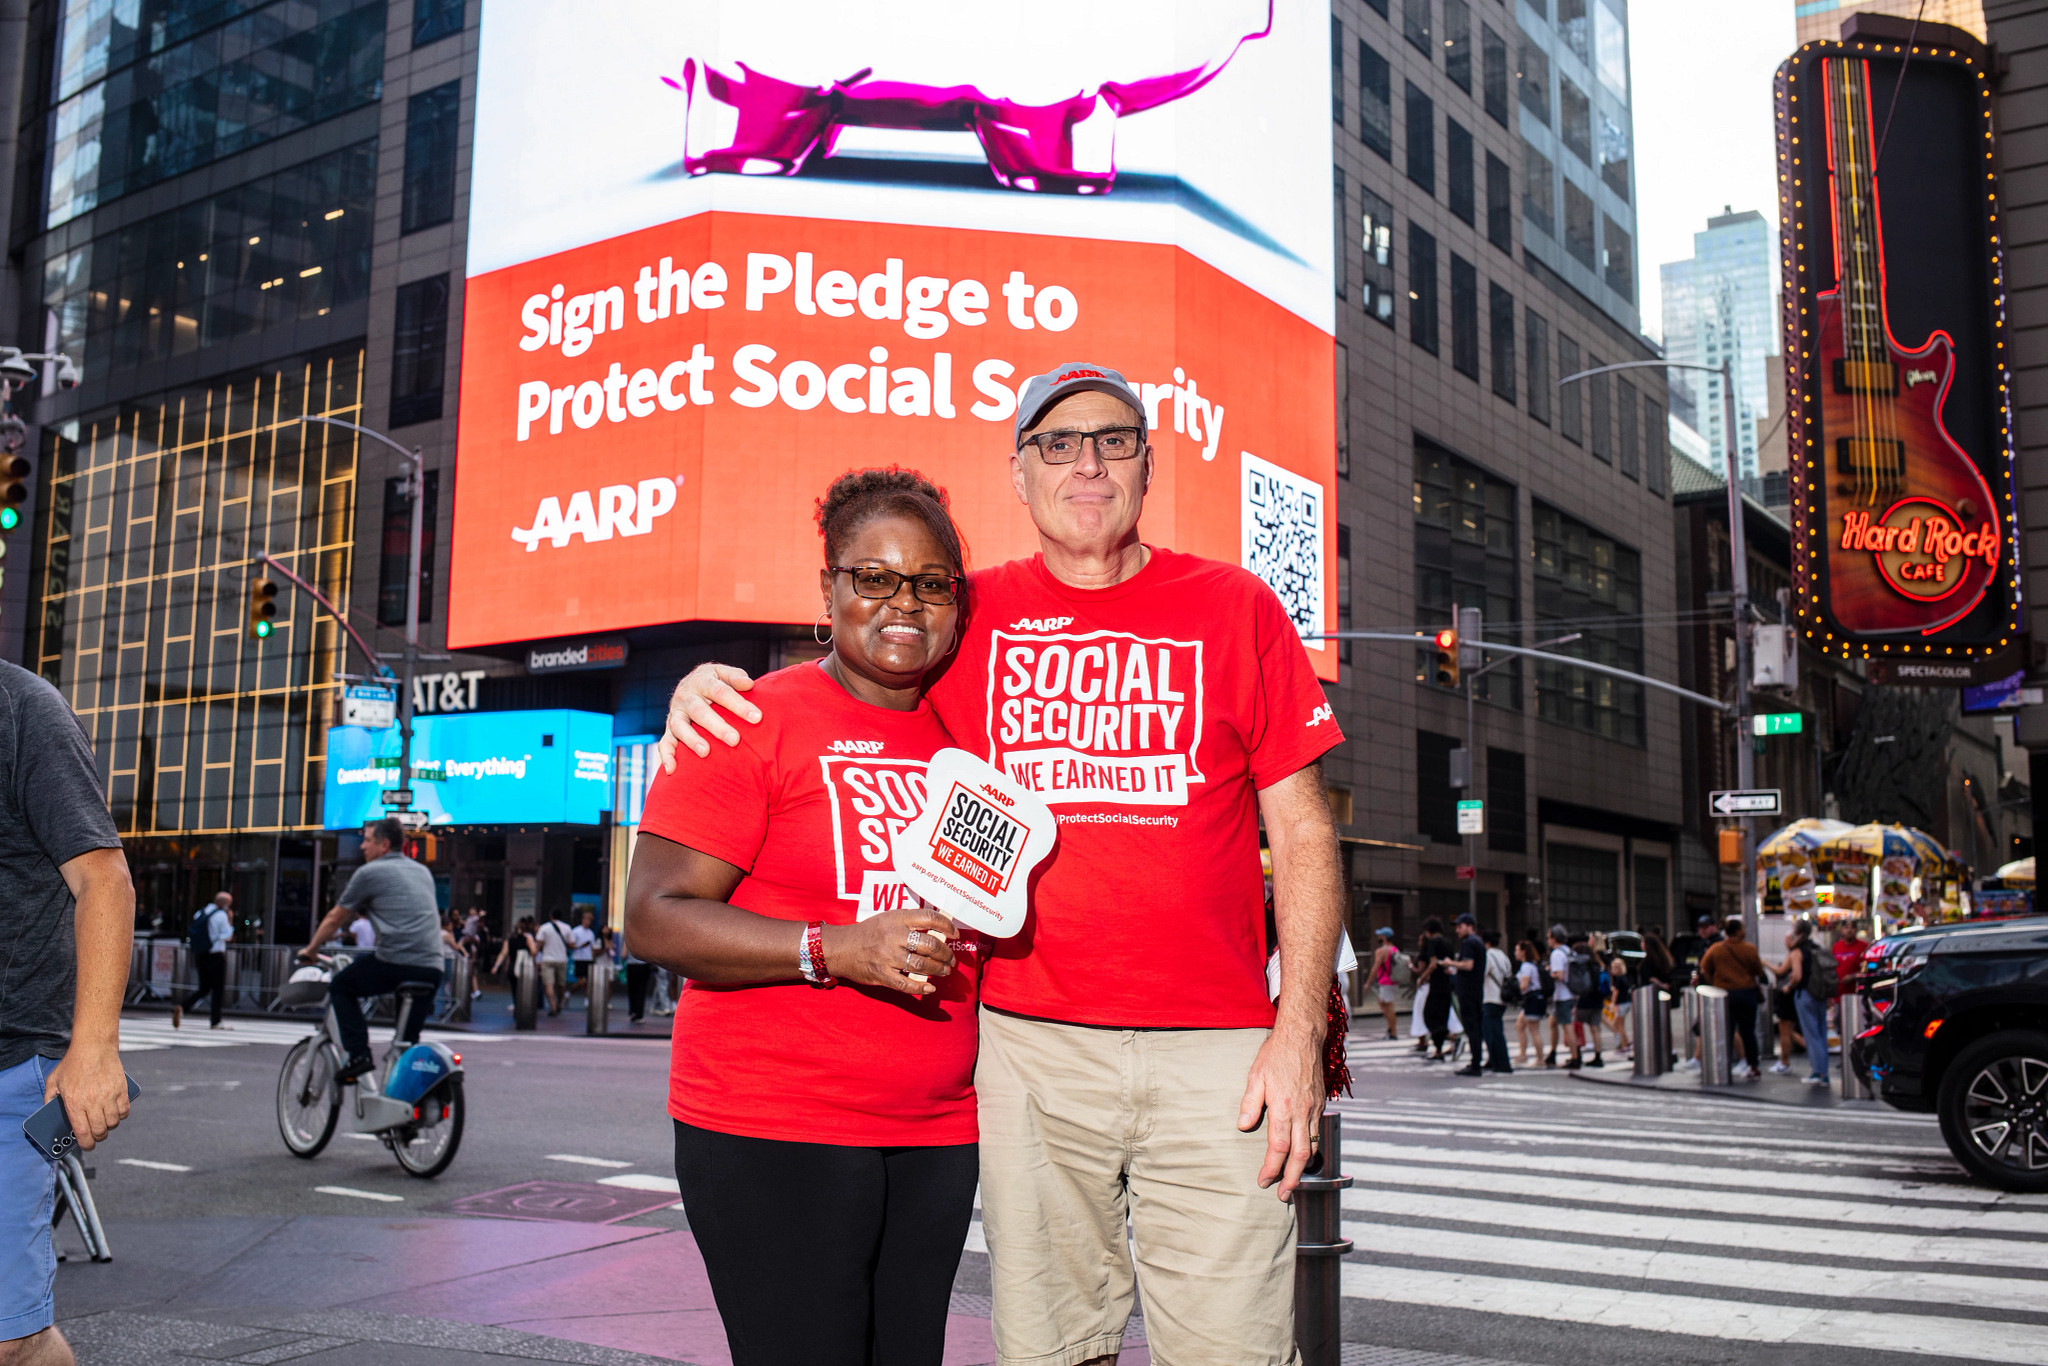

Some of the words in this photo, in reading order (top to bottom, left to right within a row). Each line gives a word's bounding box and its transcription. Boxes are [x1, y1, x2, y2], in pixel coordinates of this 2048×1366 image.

[518, 283, 625, 358] Sign
[633, 256, 729, 324] the
[738, 251, 990, 340] Pledge
[1001, 270, 1079, 332] to
[516, 343, 715, 442] Protect
[729, 346, 957, 420] Social
[969, 358, 1225, 462] Srity
[510, 474, 684, 553] AARP
[1841, 510, 1921, 552] Hard
[1923, 515, 1998, 567] Rock
[1900, 561, 1946, 582] CAFE
[1009, 616, 1074, 632] AARP
[1002, 641, 1185, 703] SOCIAL
[1897, 665, 1972, 679] SPECTACOLOR
[999, 697, 1185, 751] SECURITY
[1305, 702, 1333, 727] AA
[827, 740, 885, 754] AARP
[979, 783, 1015, 808] AARP
[1010, 761, 1045, 792] WE
[1052, 758, 1146, 793] EARNED
[1154, 764, 1176, 793] IT
[942, 817, 1012, 872] SECURITY
[951, 792, 1018, 855] SOCIAL
[911, 862, 1005, 922] aarp.org/ProtectSocialSecurity
[937, 842, 952, 863] WE
[952, 851, 989, 884] EARNED
[987, 874, 1000, 891] IT
